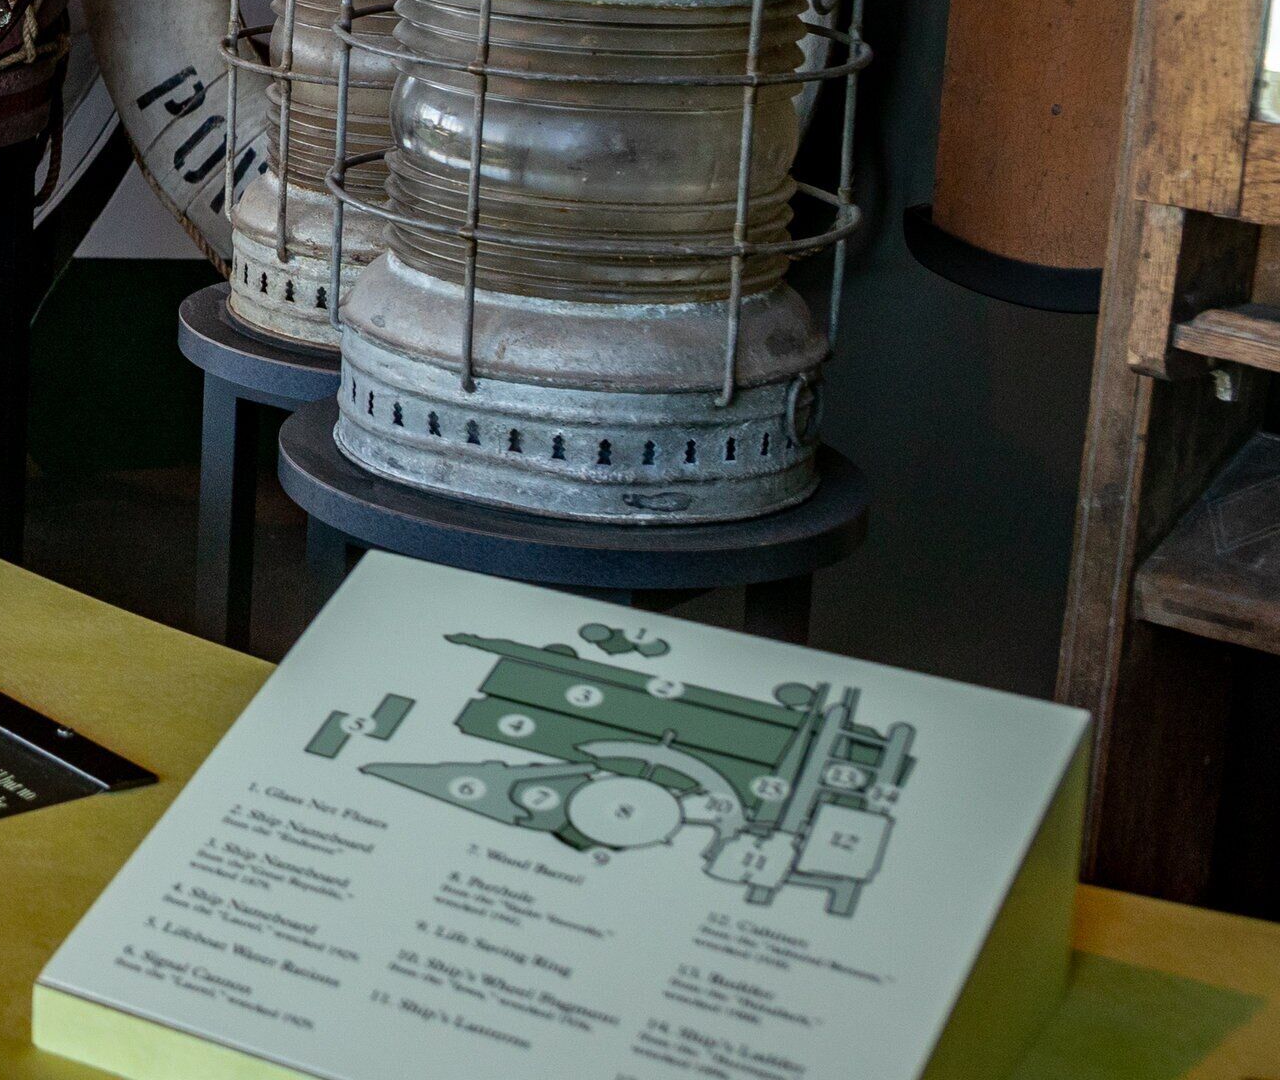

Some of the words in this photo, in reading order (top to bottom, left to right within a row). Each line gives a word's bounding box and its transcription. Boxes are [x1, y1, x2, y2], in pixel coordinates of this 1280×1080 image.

[307, 798, 337, 815] Net
[247, 809, 282, 827] Ship
[222, 842, 257, 861] Ship
[188, 887, 223, 906] Ship
